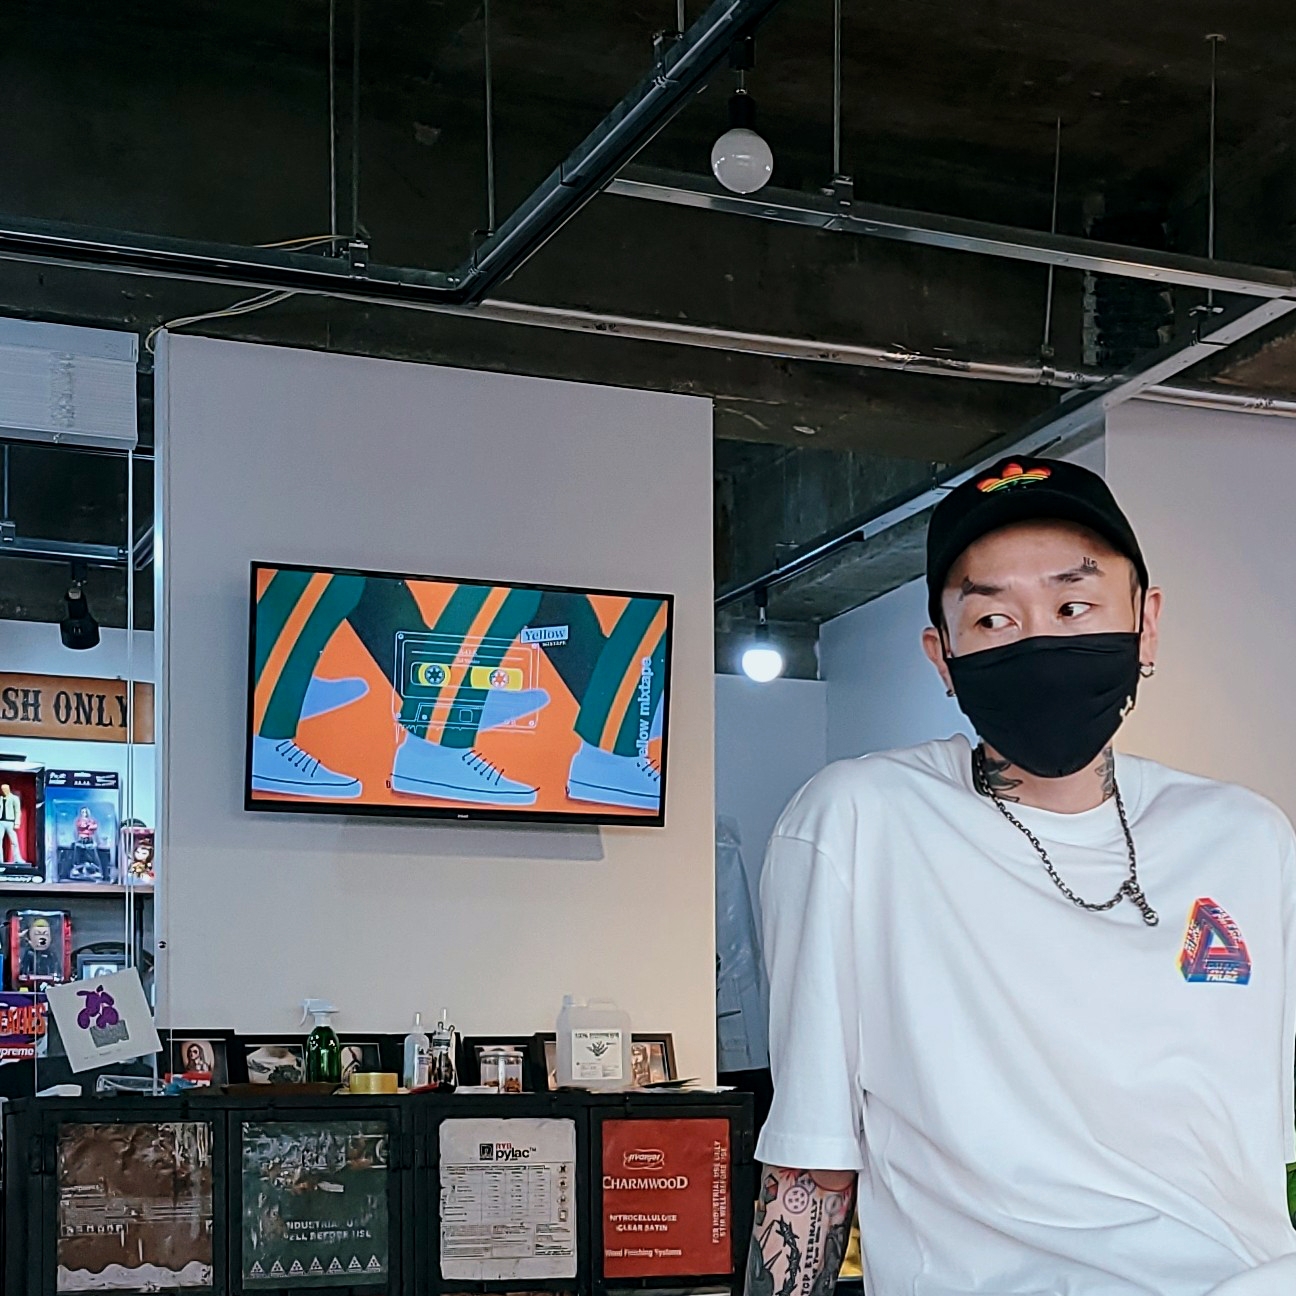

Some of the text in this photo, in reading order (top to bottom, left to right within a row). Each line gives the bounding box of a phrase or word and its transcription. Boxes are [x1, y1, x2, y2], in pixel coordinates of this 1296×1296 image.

[526, 629, 565, 641] Yellow
[638, 656, 654, 716] mixtape
[0, 687, 128, 728] SH ONLY
[0, 1048, 34, 1058] preme
[602, 1176, 688, 1190] CHARMWOOD
[800, 1274, 811, 1296] TOP
